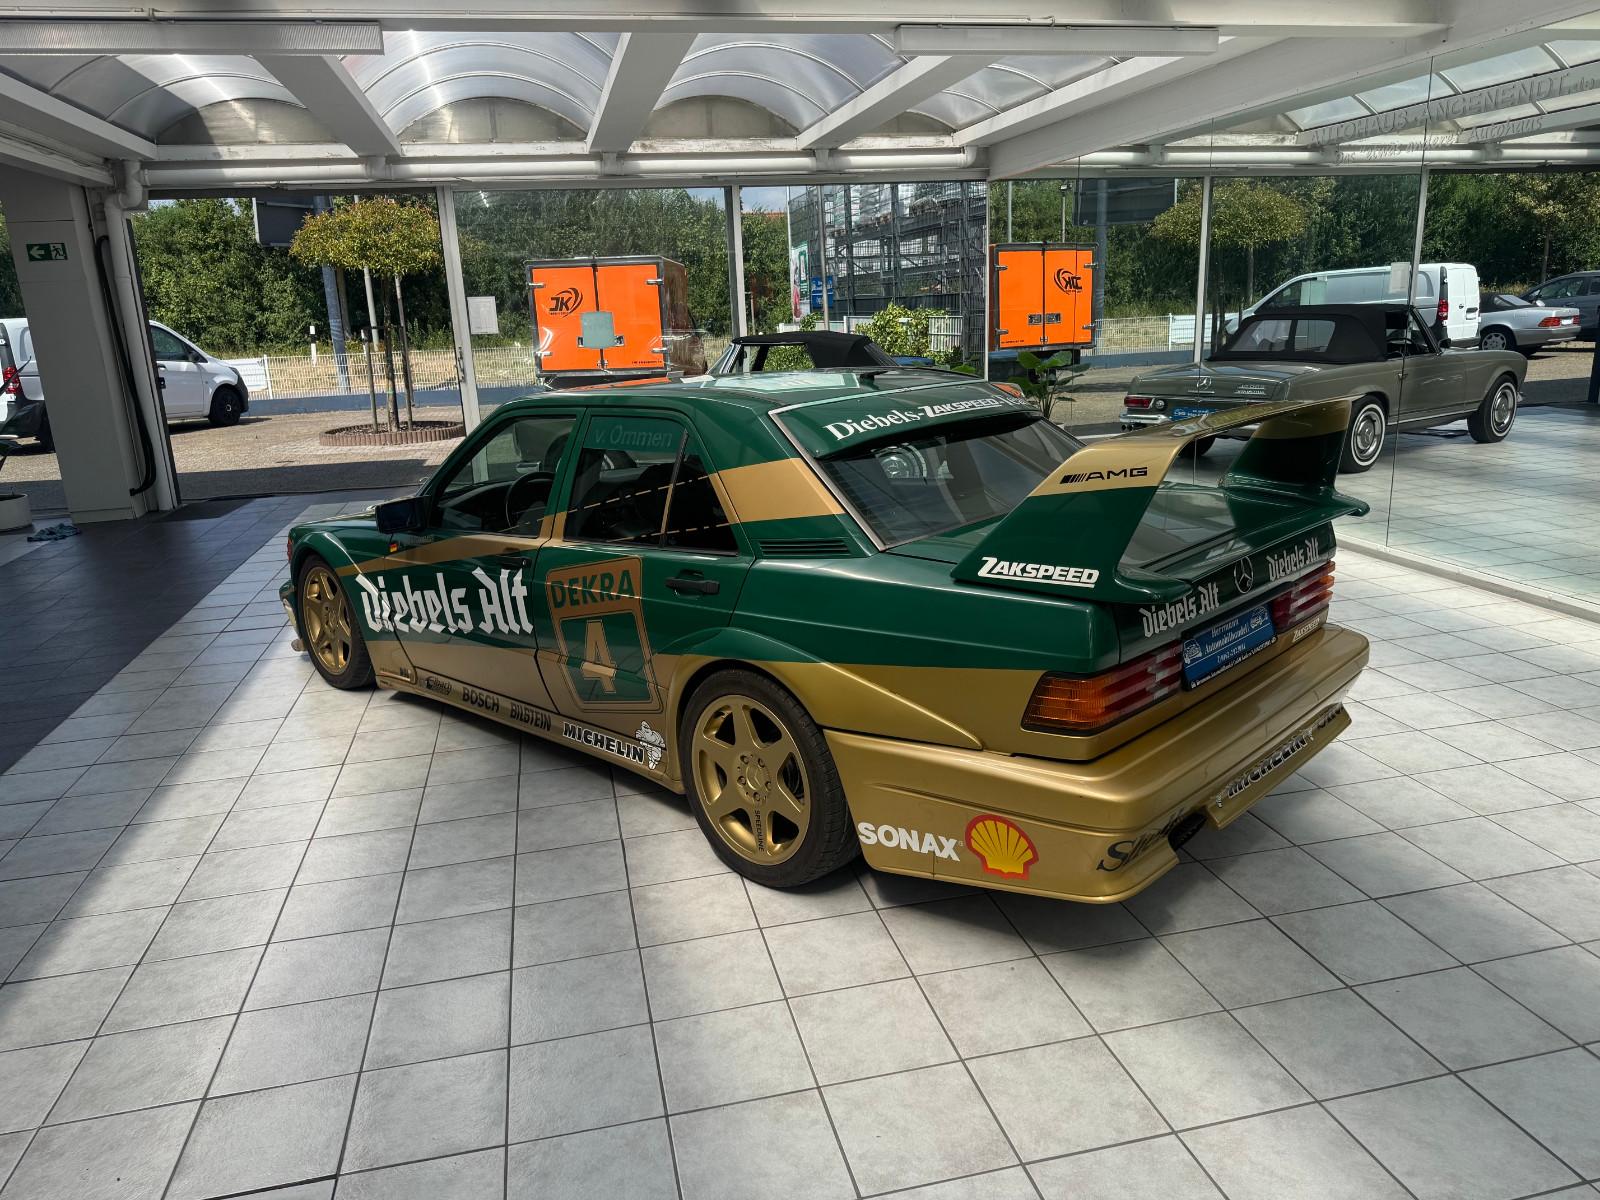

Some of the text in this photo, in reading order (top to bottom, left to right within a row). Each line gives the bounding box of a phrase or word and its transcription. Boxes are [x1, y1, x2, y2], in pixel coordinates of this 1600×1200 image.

[549, 296, 573, 312] JK
[609, 424, 673, 448] Ommen
[1085, 467, 1148, 482] AMG
[977, 556, 1100, 589] ZAKSPEED
[1266, 545, 1305, 582] Diebels
[355, 566, 533, 634] Diebels Alt
[551, 570, 635, 609] DEKRA
[1139, 581, 1220, 638] Diebels Alt
[462, 686, 500, 713] BOSCH
[510, 702, 552, 731] BILSTEIN
[562, 722, 645, 765] MICHELIN
[1228, 734, 1308, 798] MICHELIN
[857, 822, 960, 862] SONAX
